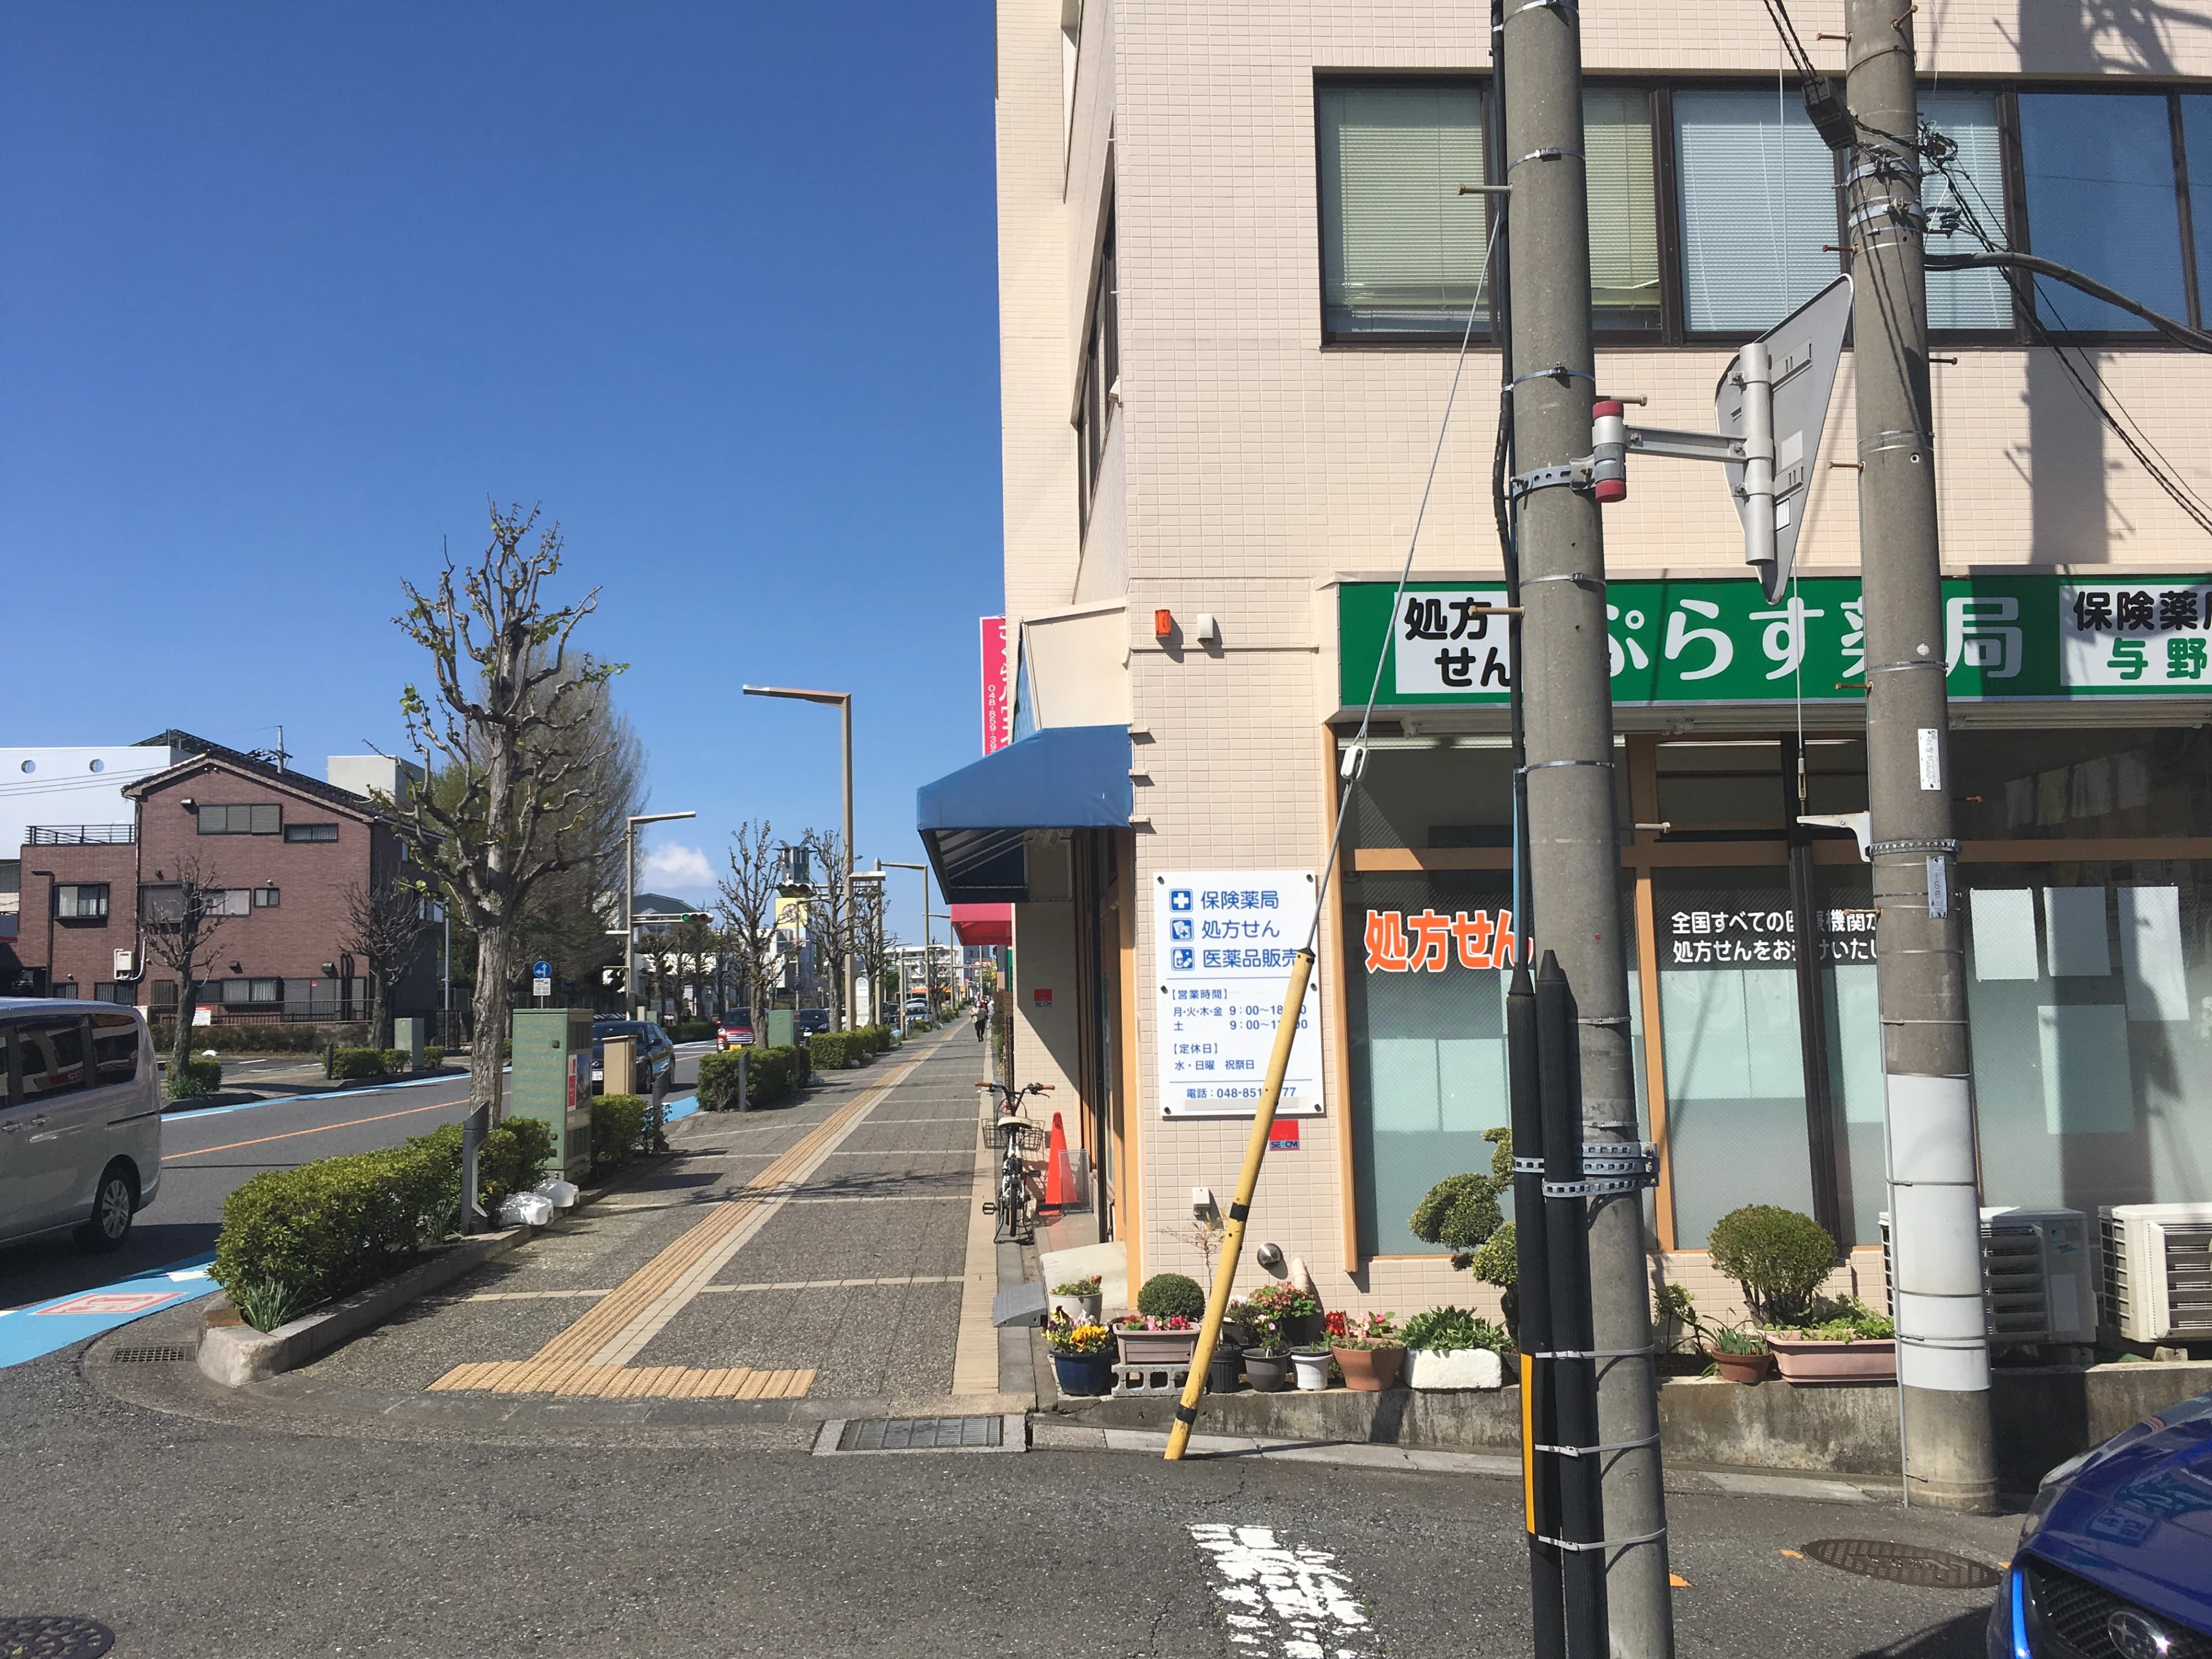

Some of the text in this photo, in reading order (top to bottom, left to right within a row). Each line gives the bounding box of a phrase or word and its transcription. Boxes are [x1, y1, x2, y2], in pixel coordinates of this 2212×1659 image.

[1403, 596, 1492, 641] 処方
[2073, 590, 2212, 631] 保険薬
[1434, 646, 1512, 687] せん
[2107, 637, 2208, 680] 与野
[1200, 890, 1279, 910] 保険薬局
[1202, 919, 1280, 940] 処方せん
[1363, 908, 1533, 974] 処方せん
[1203, 948, 1298, 968] 医薬品販売
[1172, 988, 1228, 1001] 【営業時間】
[1173, 1006, 1223, 1017] 月・火・木・金
[1174, 1021, 1184, 1031] 土
[1173, 1043, 1218, 1055] 【定休日】
[1175, 1059, 1255, 1071] 水・日曜 祝祭日
